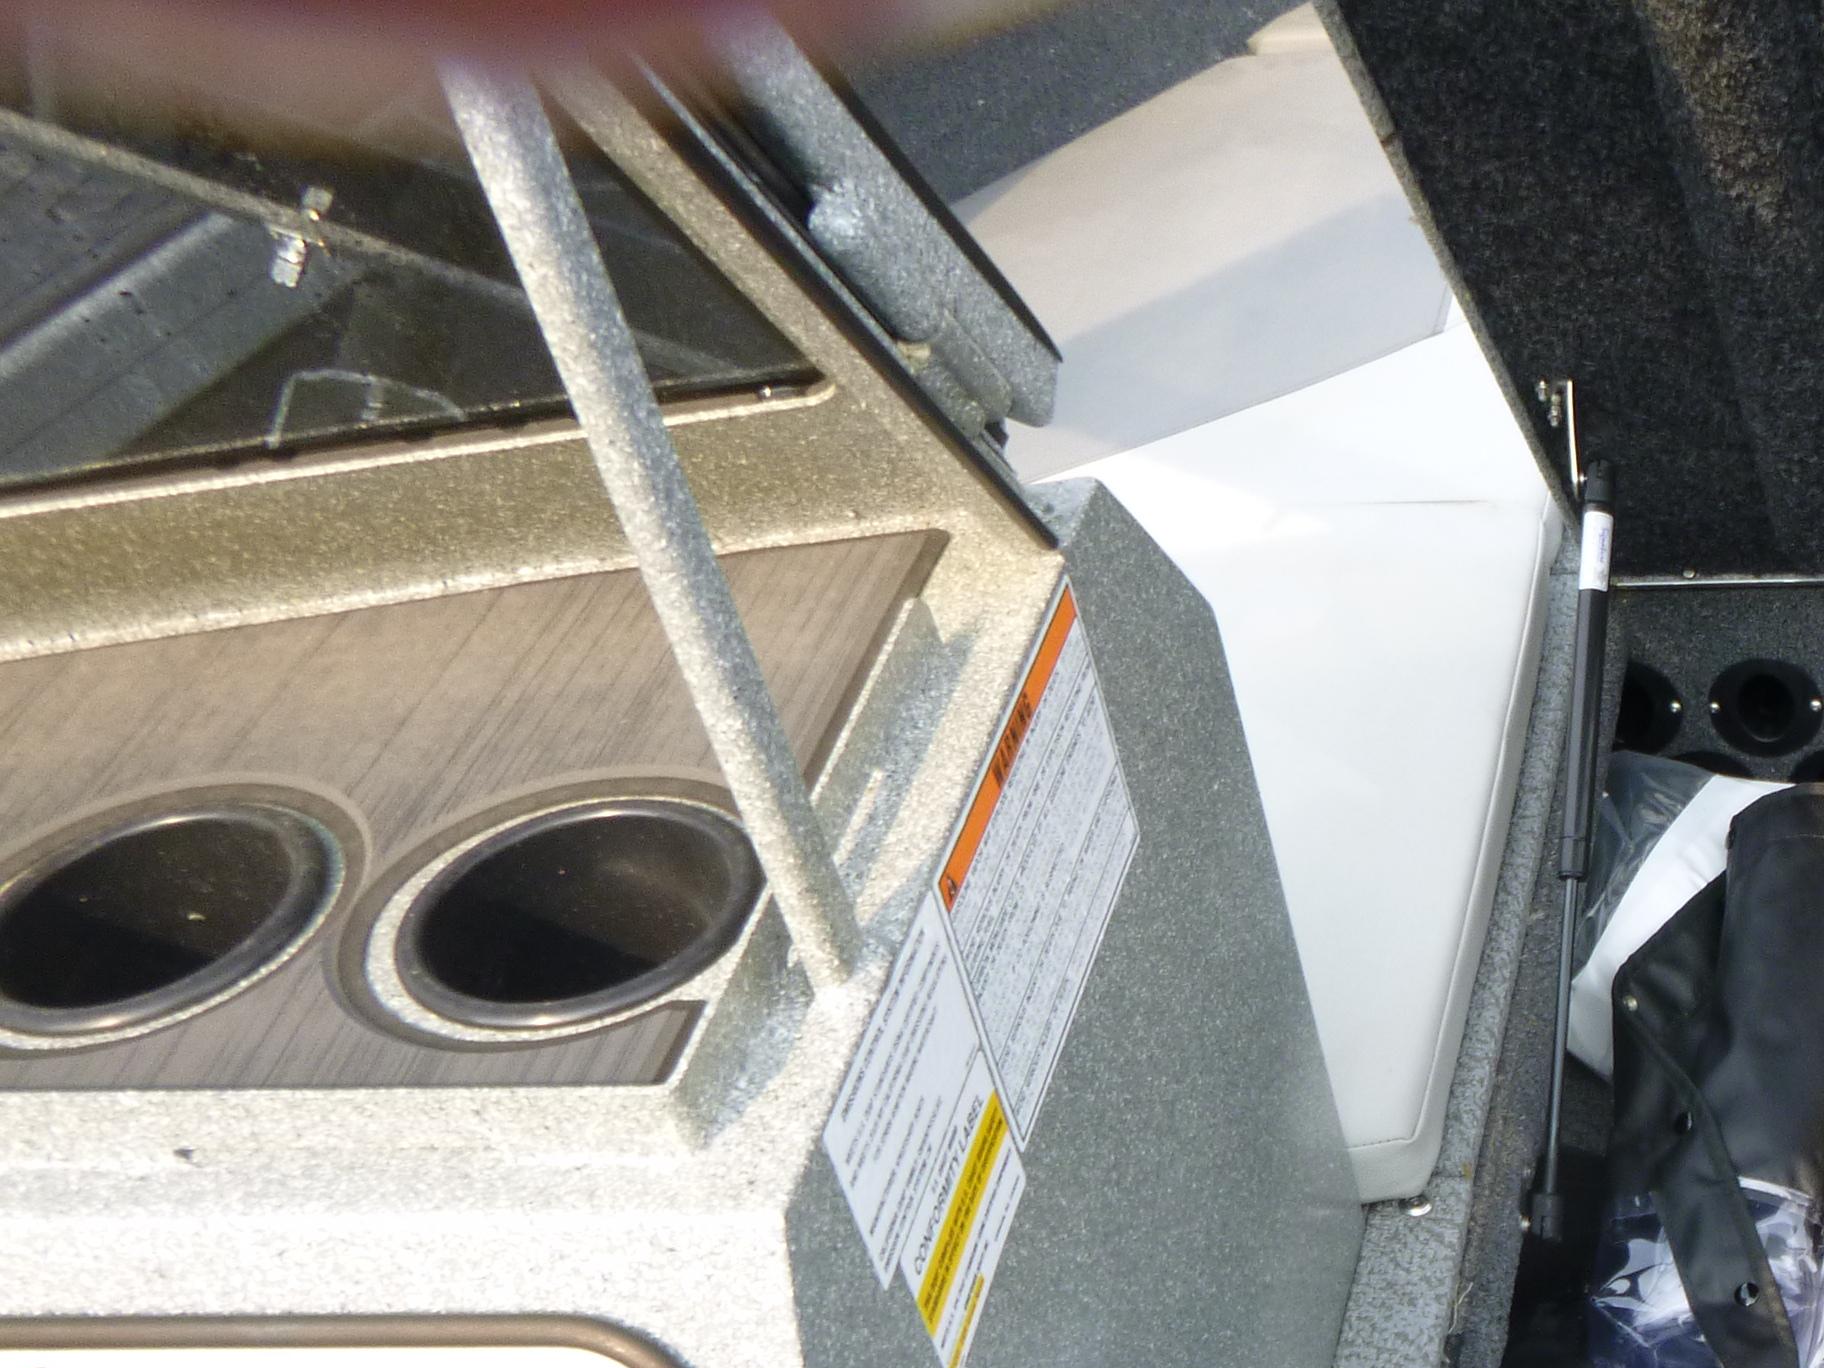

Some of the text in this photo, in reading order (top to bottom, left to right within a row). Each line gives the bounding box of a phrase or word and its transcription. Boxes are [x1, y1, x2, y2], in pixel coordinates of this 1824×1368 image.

[992, 692, 1032, 790] WARNING
[914, 1152, 960, 1276] CONFORMITY
[958, 1094, 984, 1153] LABEL
